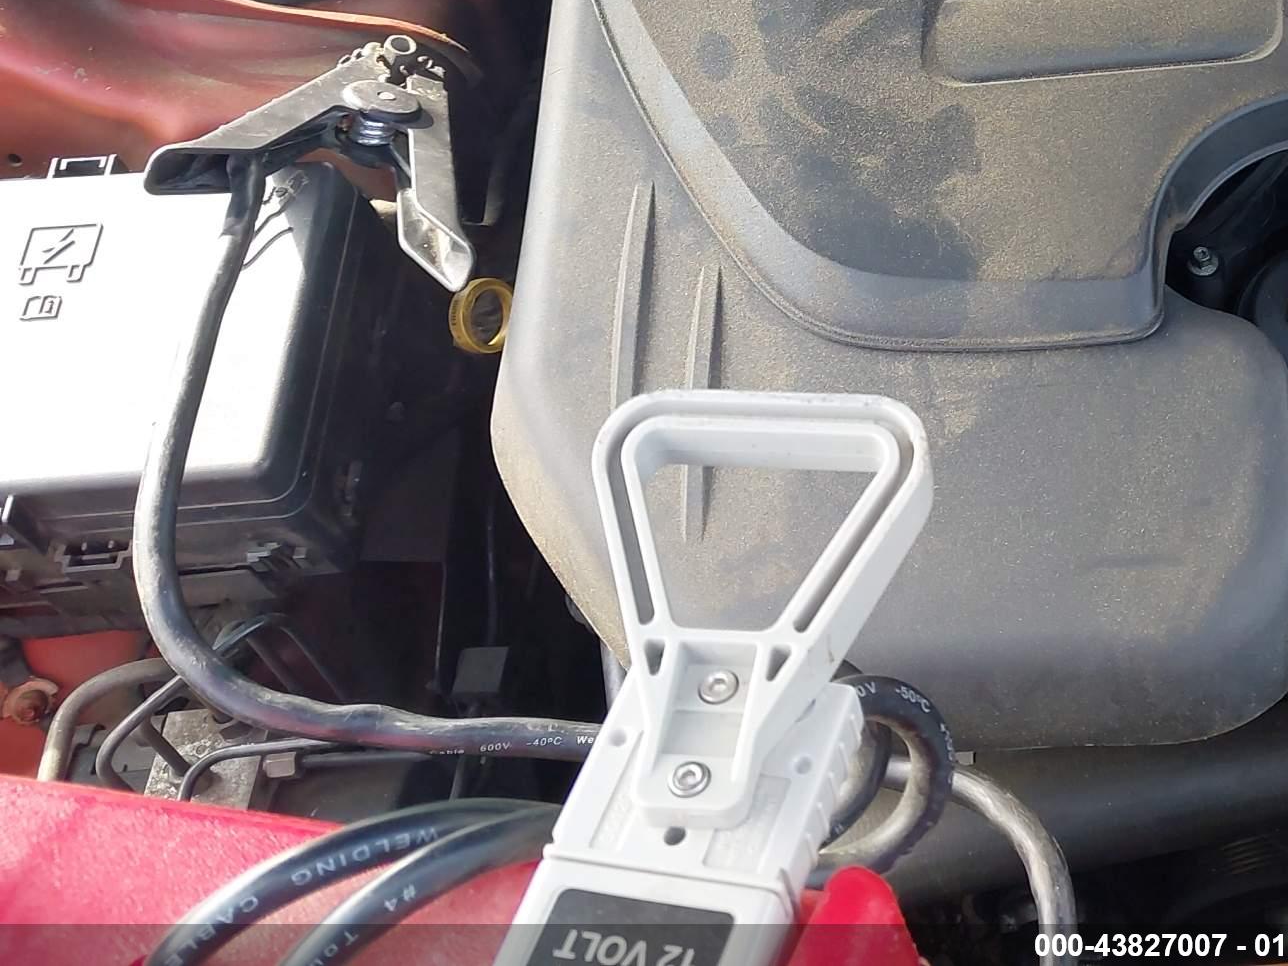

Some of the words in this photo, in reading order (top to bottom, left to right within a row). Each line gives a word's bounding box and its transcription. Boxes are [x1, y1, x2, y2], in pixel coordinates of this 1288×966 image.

[480, 741, 512, 753] 600V
[291, 825, 439, 887] WELDING
[163, 895, 260, 966] CABLE
[552, 928, 648, 966] VOLT
